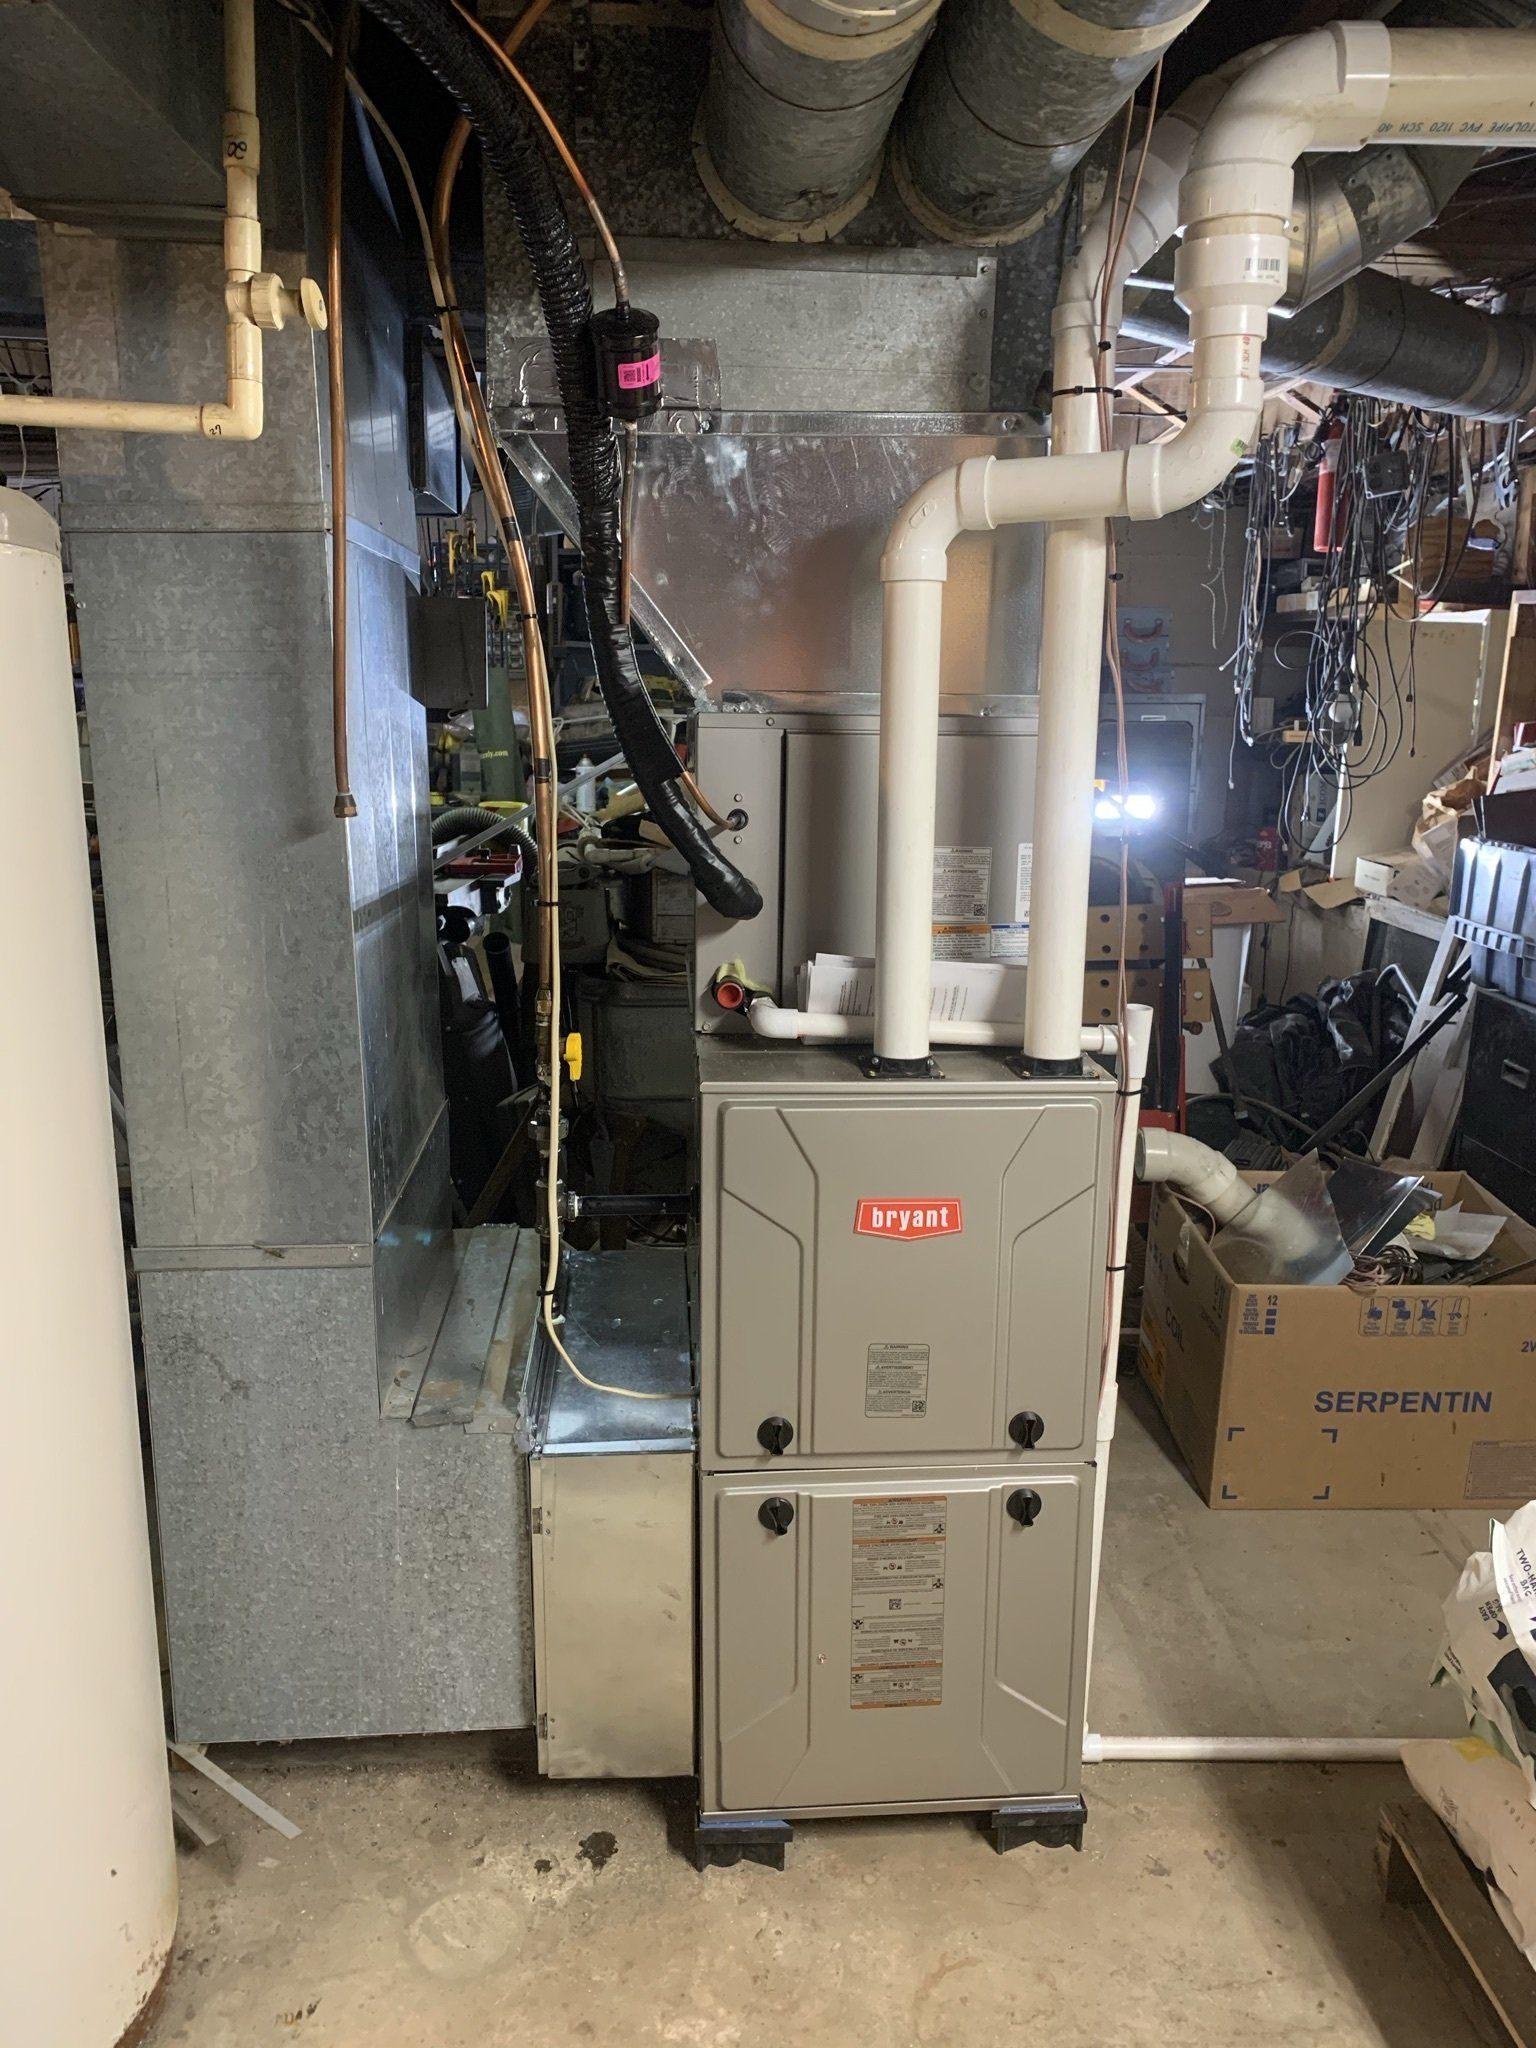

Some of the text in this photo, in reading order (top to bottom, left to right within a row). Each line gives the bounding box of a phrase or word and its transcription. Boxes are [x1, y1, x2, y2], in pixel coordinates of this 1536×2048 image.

[1377, 121, 1393, 133] 40
[1399, 121, 1424, 133] SCH
[1429, 121, 1454, 133] 1120
[1459, 121, 1483, 133] PVC
[871, 1206, 949, 1231] bryant
[1267, 1295, 1278, 1306] 12
[1165, 1306, 1185, 1353] COIL
[1313, 1391, 1493, 1413] SERPENTIN
[1520, 1579, 1532, 1597] BAG
